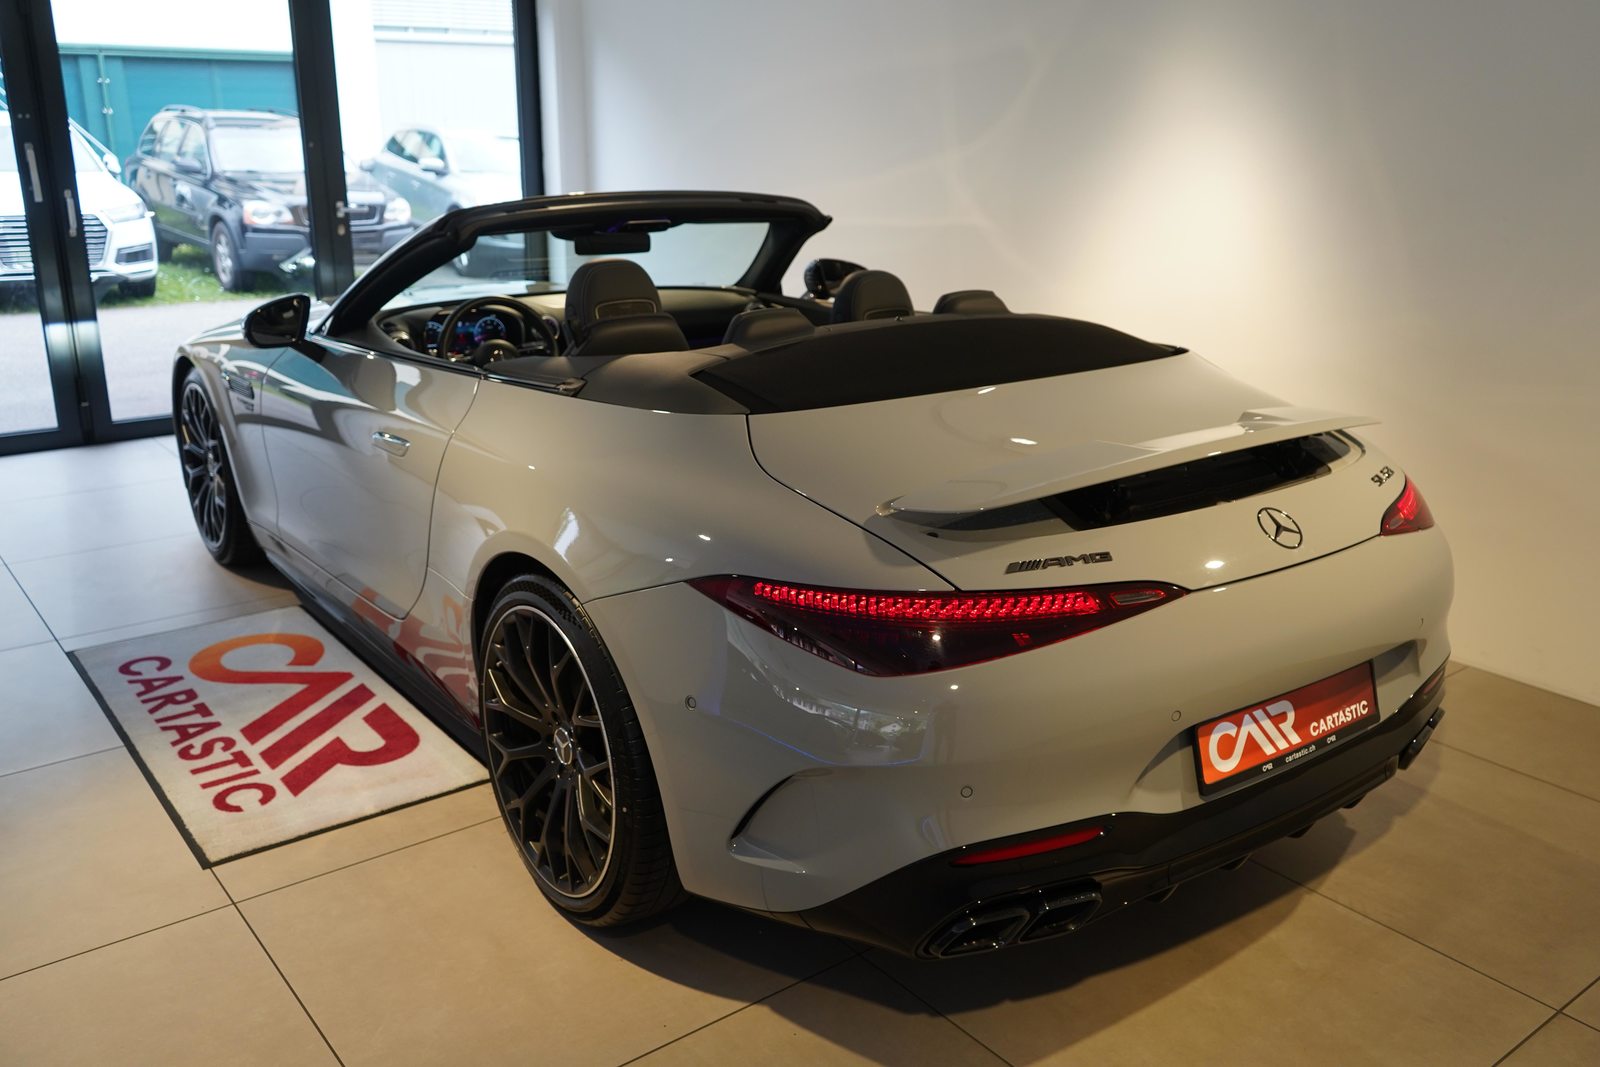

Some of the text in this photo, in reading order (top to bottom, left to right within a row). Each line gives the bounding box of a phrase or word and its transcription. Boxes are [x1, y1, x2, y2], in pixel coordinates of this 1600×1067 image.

[1041, 552, 1113, 570] AMG
[1309, 700, 1369, 737] CARTASTIC
[118, 656, 277, 813] CARTASTIC
[1285, 744, 1317, 763] cartastic.ch
